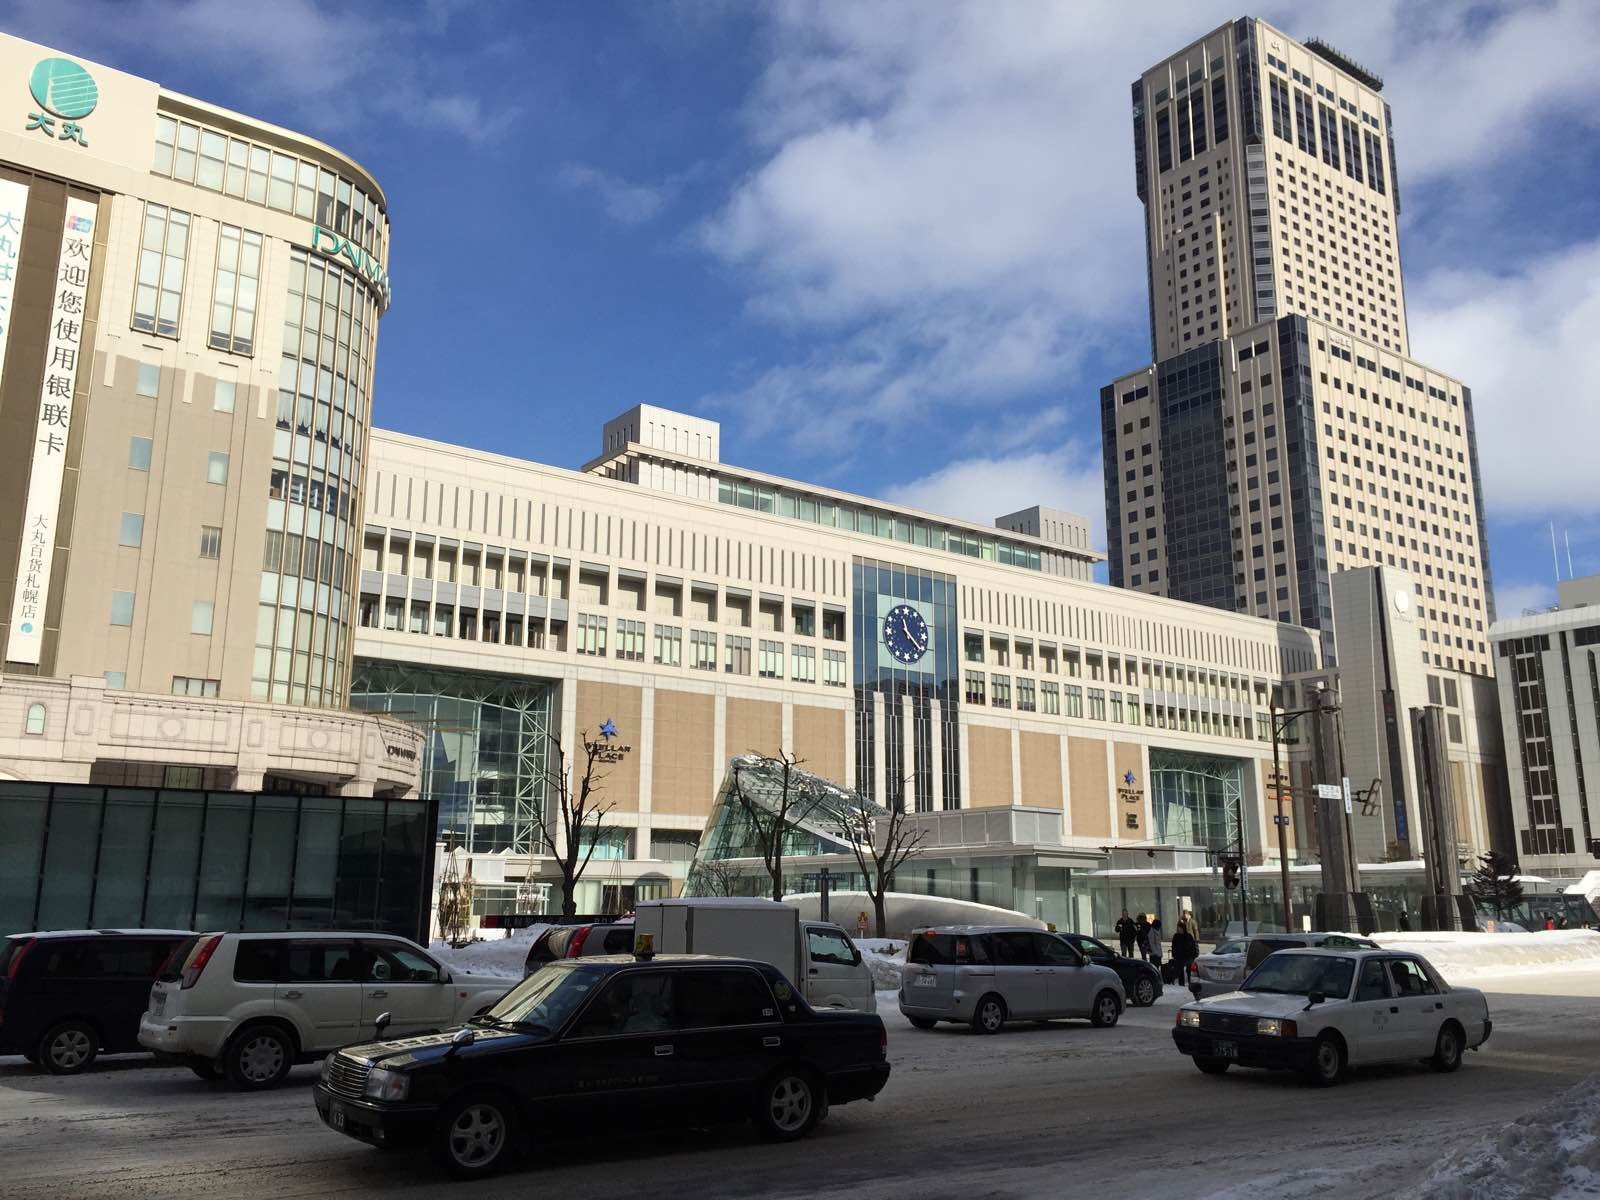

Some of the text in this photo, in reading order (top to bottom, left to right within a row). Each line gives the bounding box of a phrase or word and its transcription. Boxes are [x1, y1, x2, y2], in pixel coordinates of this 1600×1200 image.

[25, 113, 88, 147] 大丸
[39, 237, 89, 456] 欢迎您使用银联卡
[20, 514, 48, 619] 大丸百货札幌店
